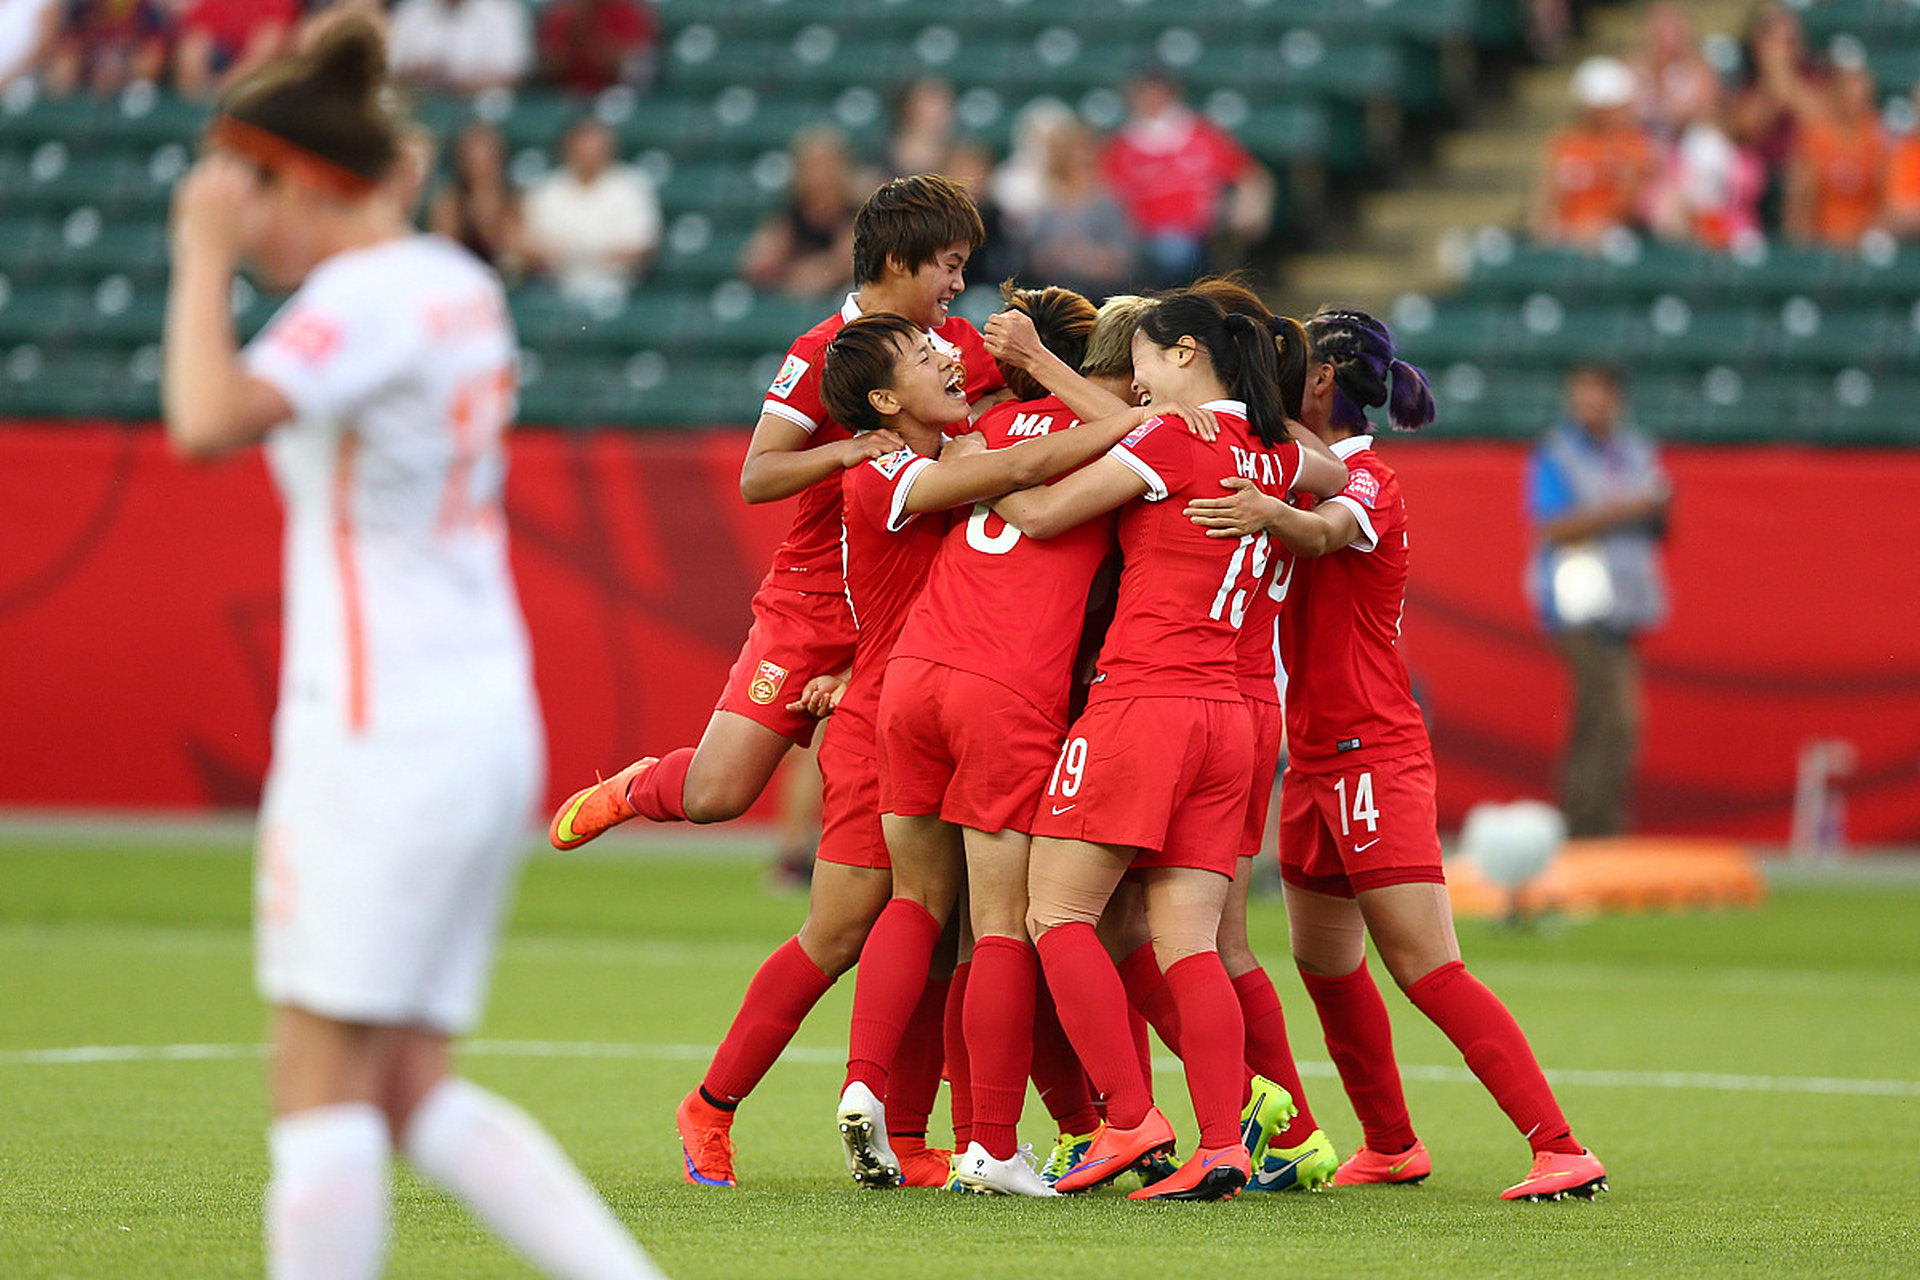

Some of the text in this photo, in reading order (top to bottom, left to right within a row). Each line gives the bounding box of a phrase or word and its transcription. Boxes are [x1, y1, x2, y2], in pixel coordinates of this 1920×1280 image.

[1007, 412, 1054, 436] MA
[1048, 737, 1089, 798] 19
[1334, 772, 1380, 836] 14
